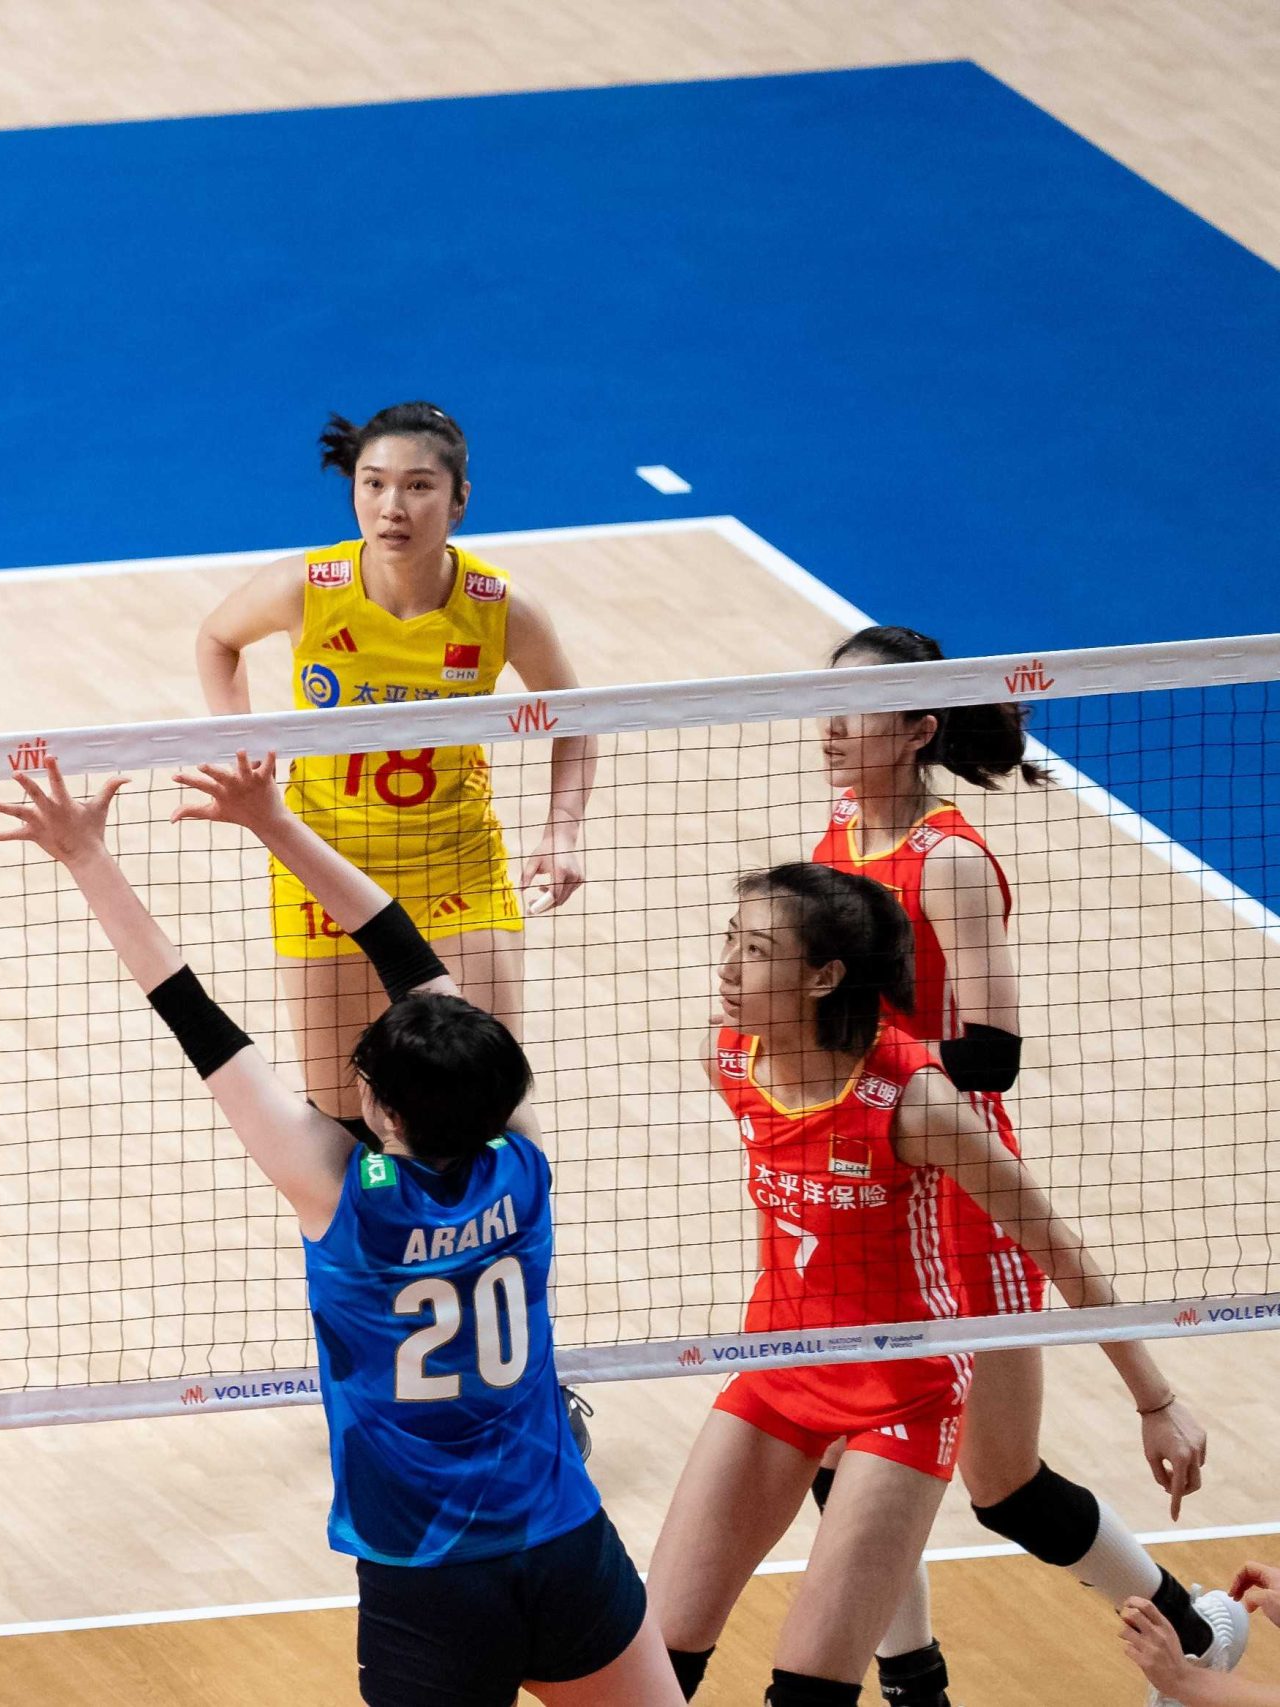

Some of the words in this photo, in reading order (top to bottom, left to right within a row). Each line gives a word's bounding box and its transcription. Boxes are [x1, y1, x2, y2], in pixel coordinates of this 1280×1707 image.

[311, 562, 352, 580] 光明
[467, 573, 507, 596] 光明
[445, 669, 476, 680] CHN
[1004, 659, 1055, 694] VNL
[507, 698, 559, 733] VNL
[754, 1163, 888, 1211] 太平洋保险
[756, 1188, 802, 1219] CPIC
[403, 1195, 517, 1264] ARAKI
[774, 1216, 820, 1280] 7
[394, 1255, 529, 1403] 20
[714, 1339, 824, 1361] VOLLEYBALL
[214, 1379, 318, 1400] VOLLEYBAL
